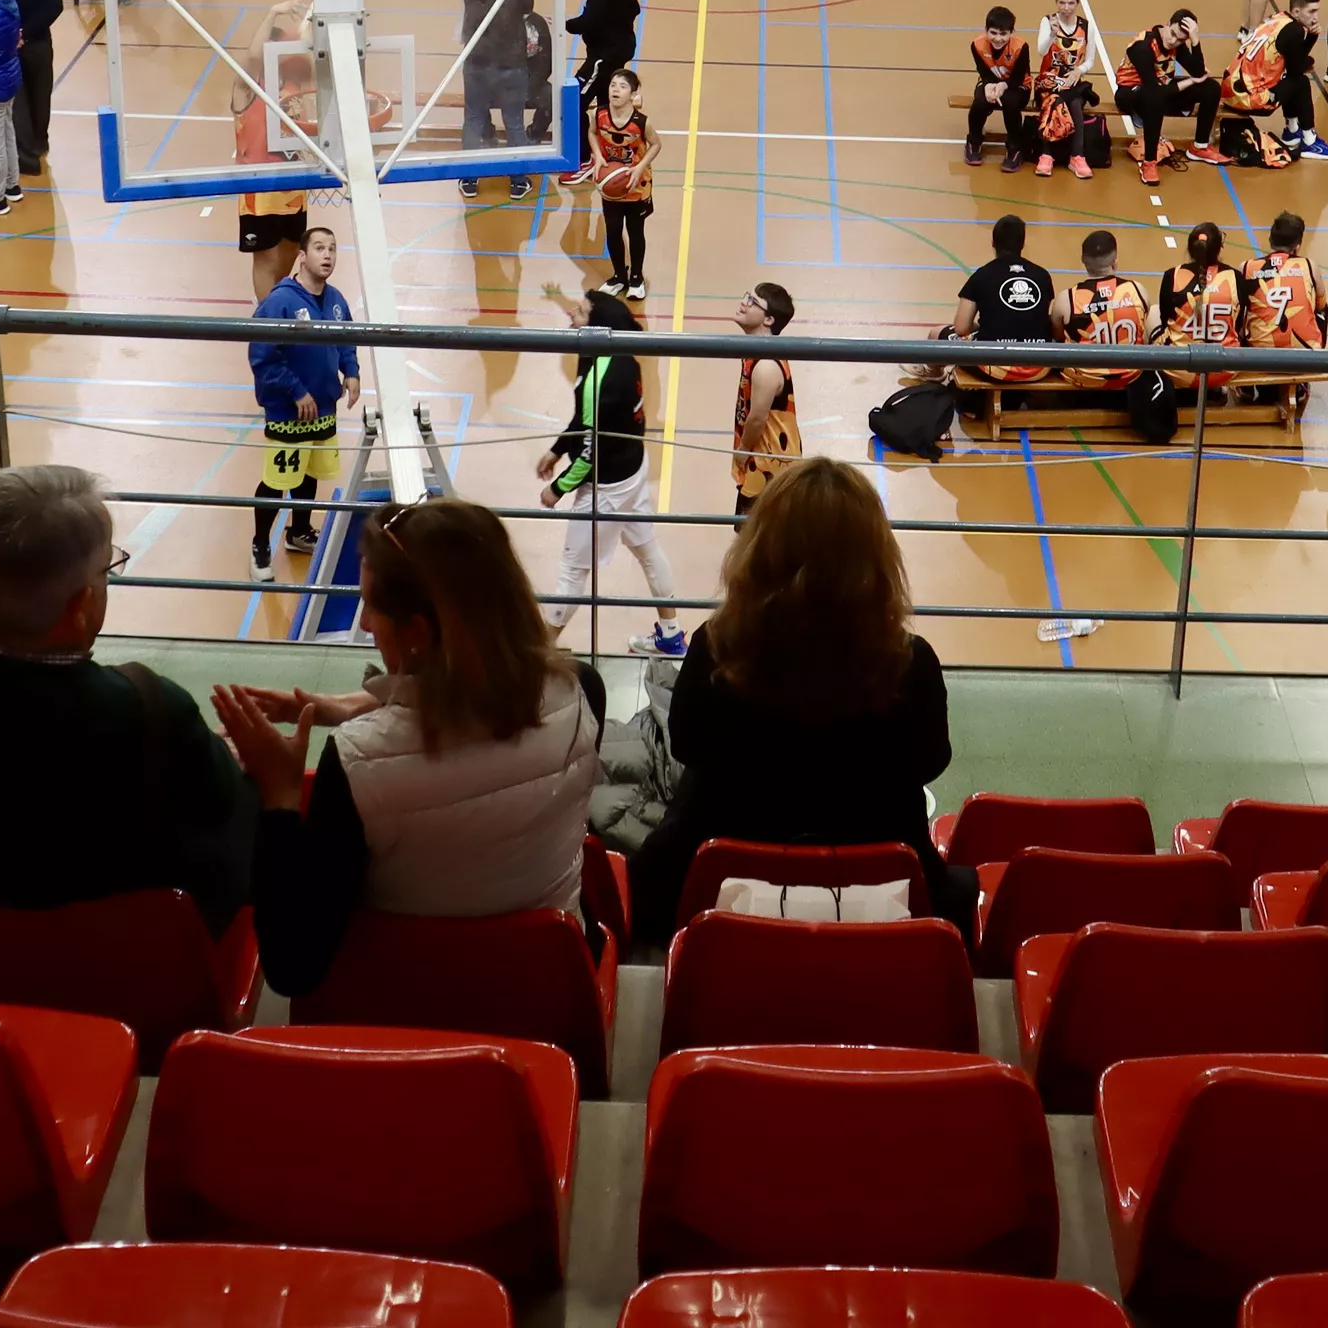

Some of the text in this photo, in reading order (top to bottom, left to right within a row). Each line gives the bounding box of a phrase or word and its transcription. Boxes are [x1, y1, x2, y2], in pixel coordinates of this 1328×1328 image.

[1082, 297, 1134, 314] ESTEBAN
[1266, 286, 1294, 327] 9
[273, 449, 301, 474] 44
